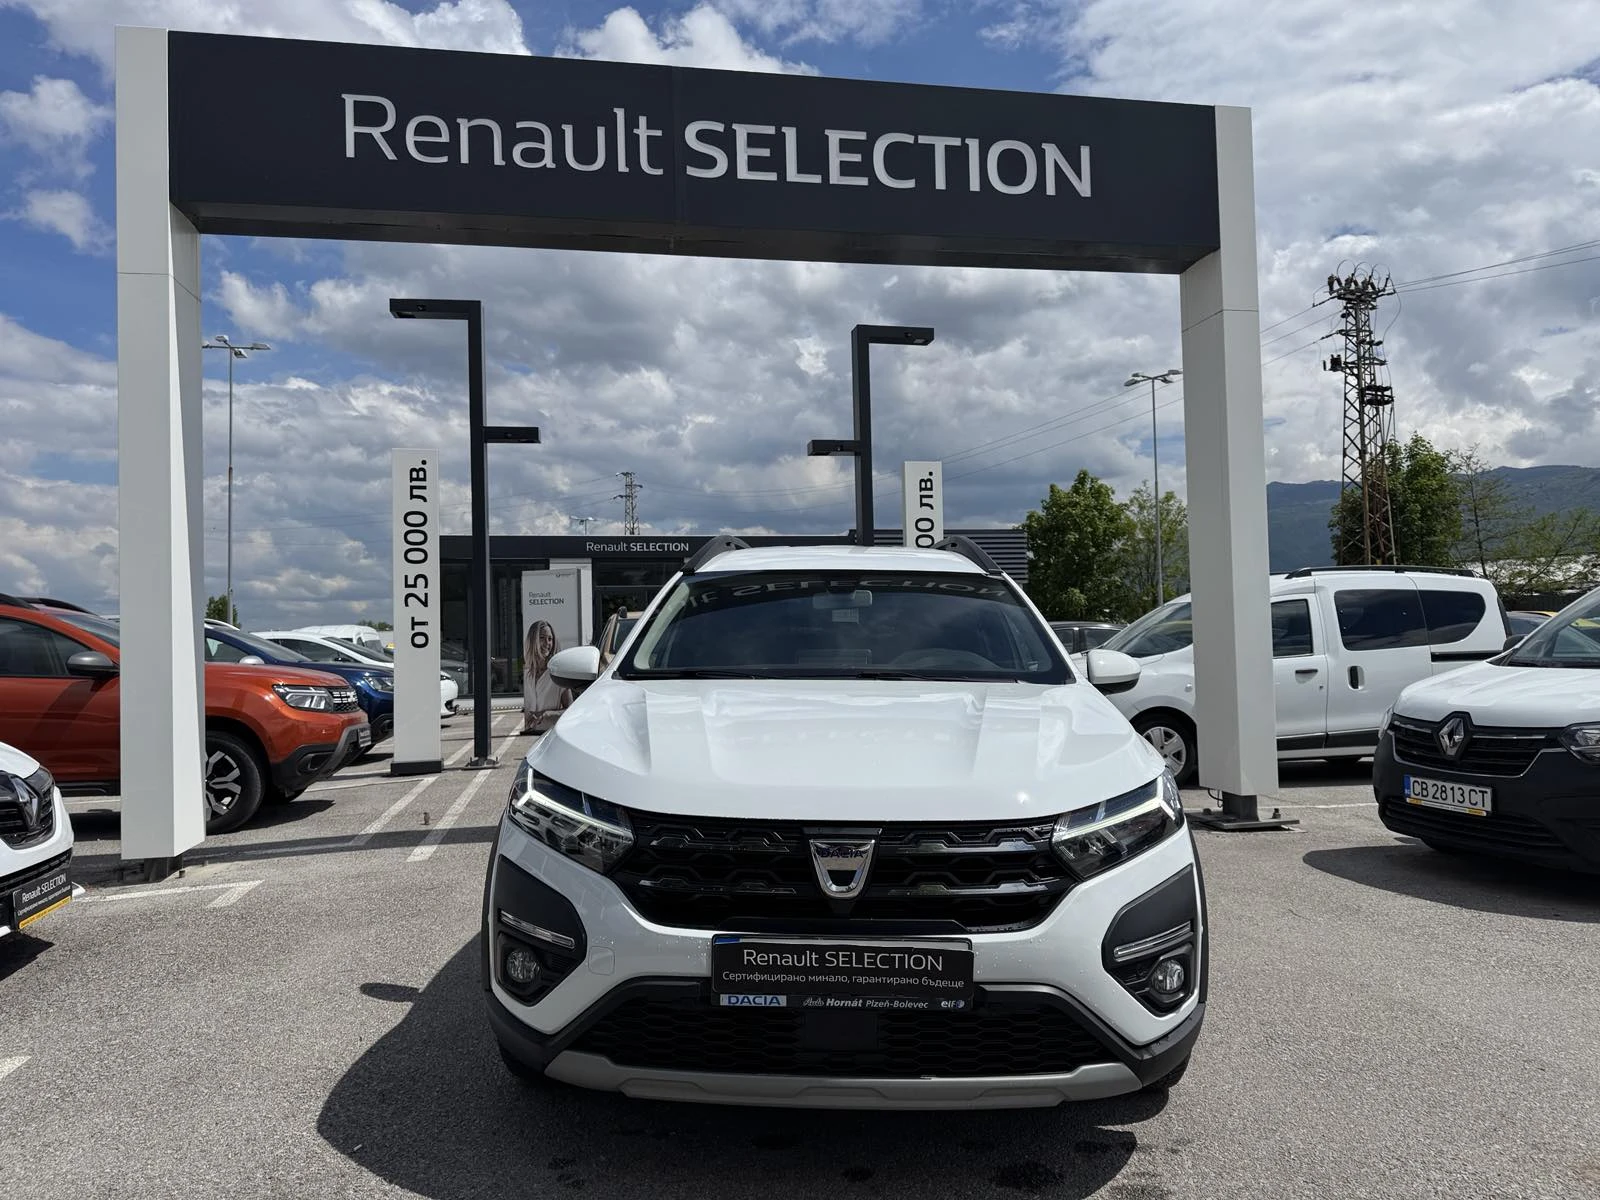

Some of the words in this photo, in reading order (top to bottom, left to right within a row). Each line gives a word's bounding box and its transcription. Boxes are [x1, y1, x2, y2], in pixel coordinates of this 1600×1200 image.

[341, 93, 664, 175] Renault
[684, 120, 1092, 198] SELECTION
[409, 459, 428, 502] лв.
[919, 471, 934, 510] лв.
[403, 511, 428, 565] 000
[586, 541, 628, 552] Renault
[630, 543, 689, 552] SELECTION
[404, 573, 429, 608] 25
[411, 617, 429, 649] от
[1412, 780, 1429, 798] CB
[1431, 783, 1466, 804] 2813
[1468, 789, 1488, 808] CT
[22, 886, 41, 903] Renault
[41, 873, 67, 894] SELECTION
[743, 949, 819, 967] Renault
[825, 951, 943, 971] SELECTION
[722, 971, 806, 983] Сертифицирано
[808, 975, 850, 983] минало,
[852, 975, 919, 985] гарантирано
[921, 977, 965, 988] бъдеще
[727, 995, 781, 1006] DACIA
[826, 998, 863, 1008] Hornát
[865, 999, 929, 1009] Plzeň-Bolevec
